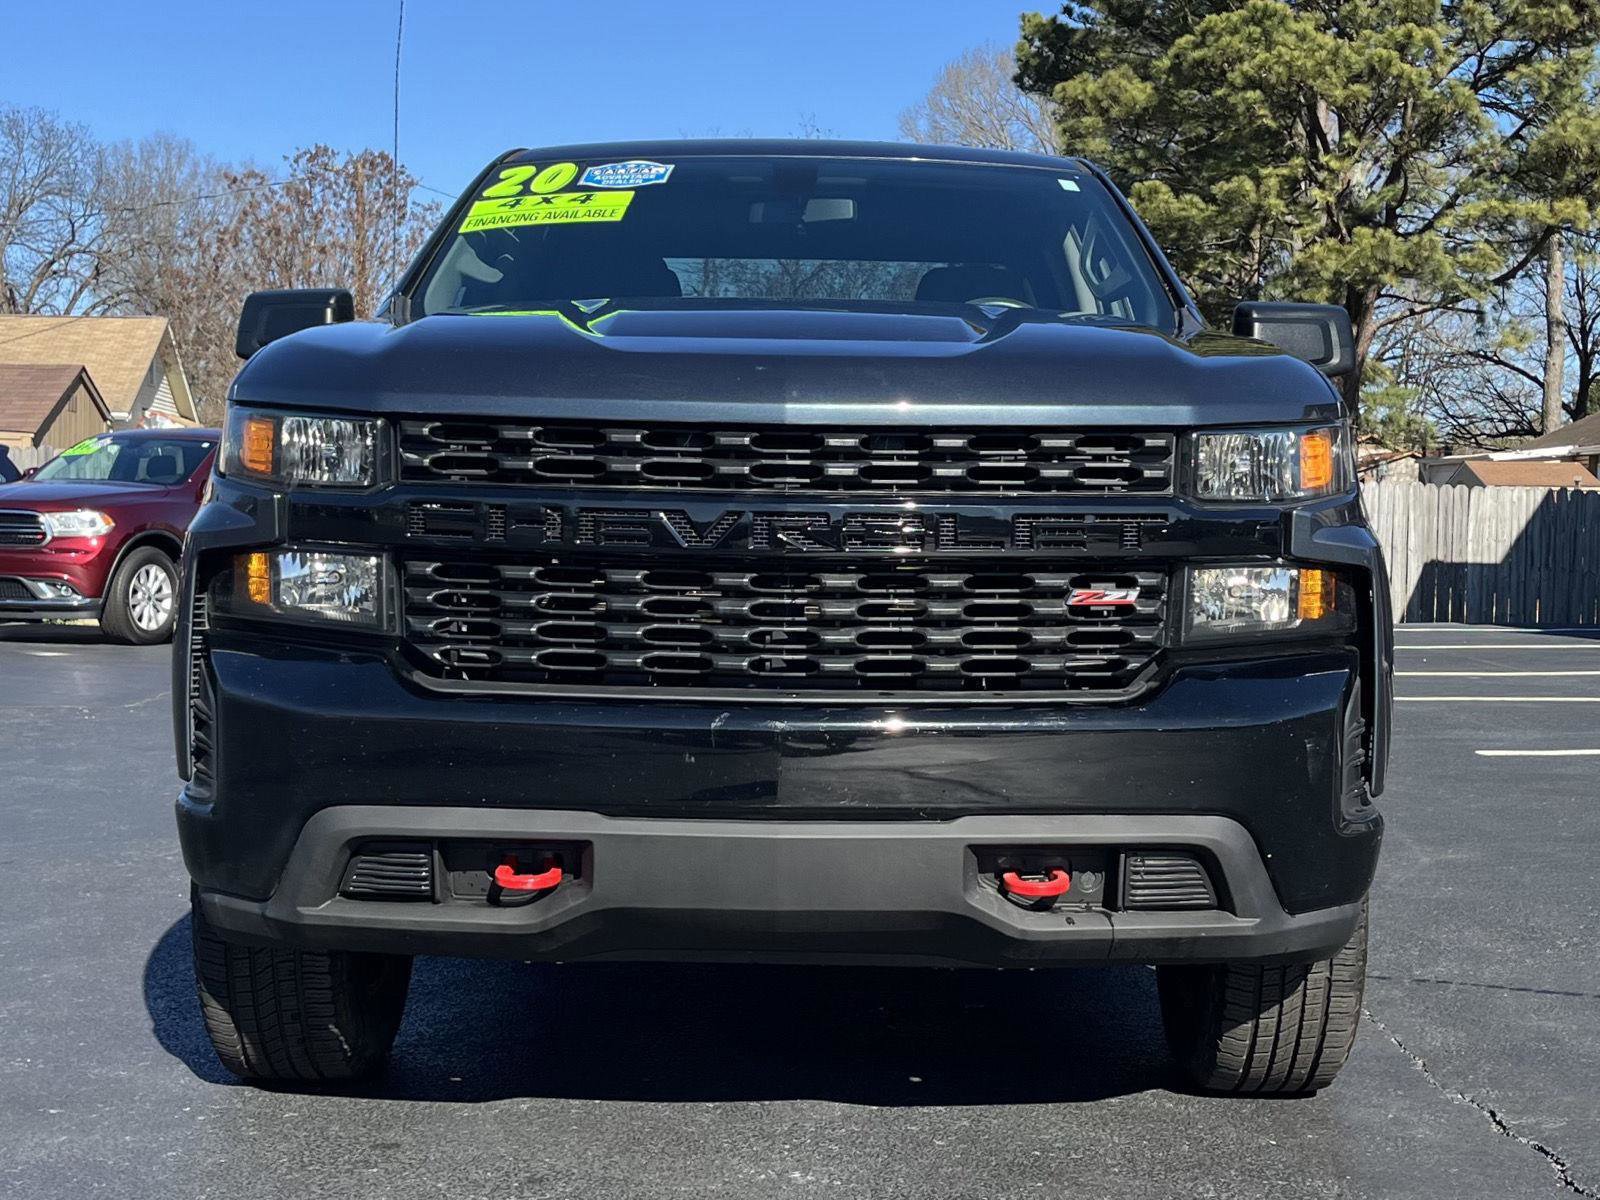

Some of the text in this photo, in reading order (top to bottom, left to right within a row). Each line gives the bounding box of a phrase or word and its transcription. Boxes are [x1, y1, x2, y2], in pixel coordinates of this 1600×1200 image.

[482, 162, 578, 198] 20
[593, 173, 656, 181] ADVANTAGE
[465, 207, 620, 229] FINANCING AVAILABLE
[406, 502, 1170, 552] CHEVROLET
[1066, 588, 1140, 606] Z71
